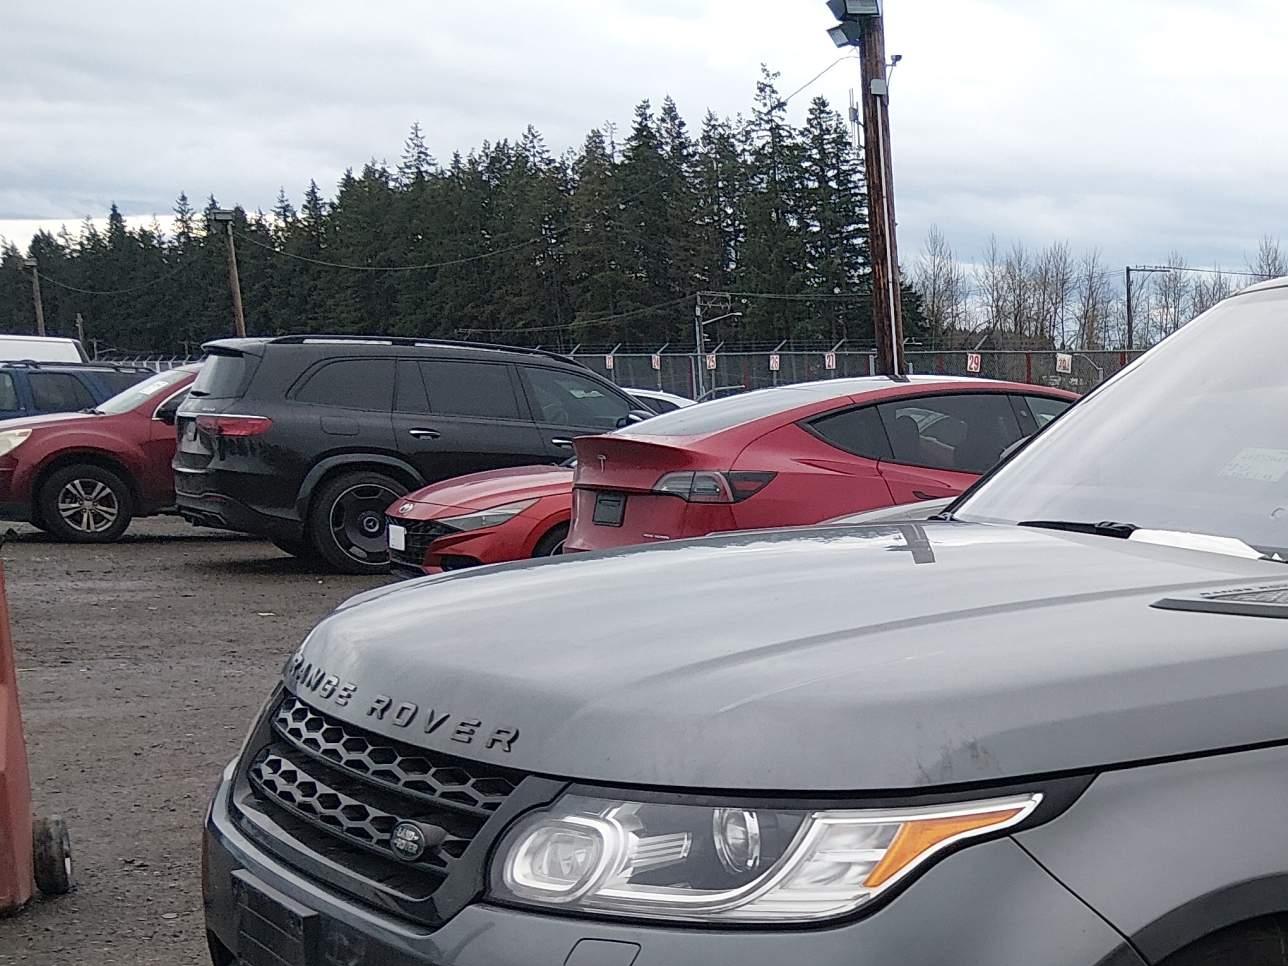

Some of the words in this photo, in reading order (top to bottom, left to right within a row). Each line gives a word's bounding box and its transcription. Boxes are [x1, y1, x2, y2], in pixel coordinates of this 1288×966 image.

[969, 355, 979, 371] 29
[289, 654, 357, 706] RANGE
[367, 694, 519, 753] ROVER
